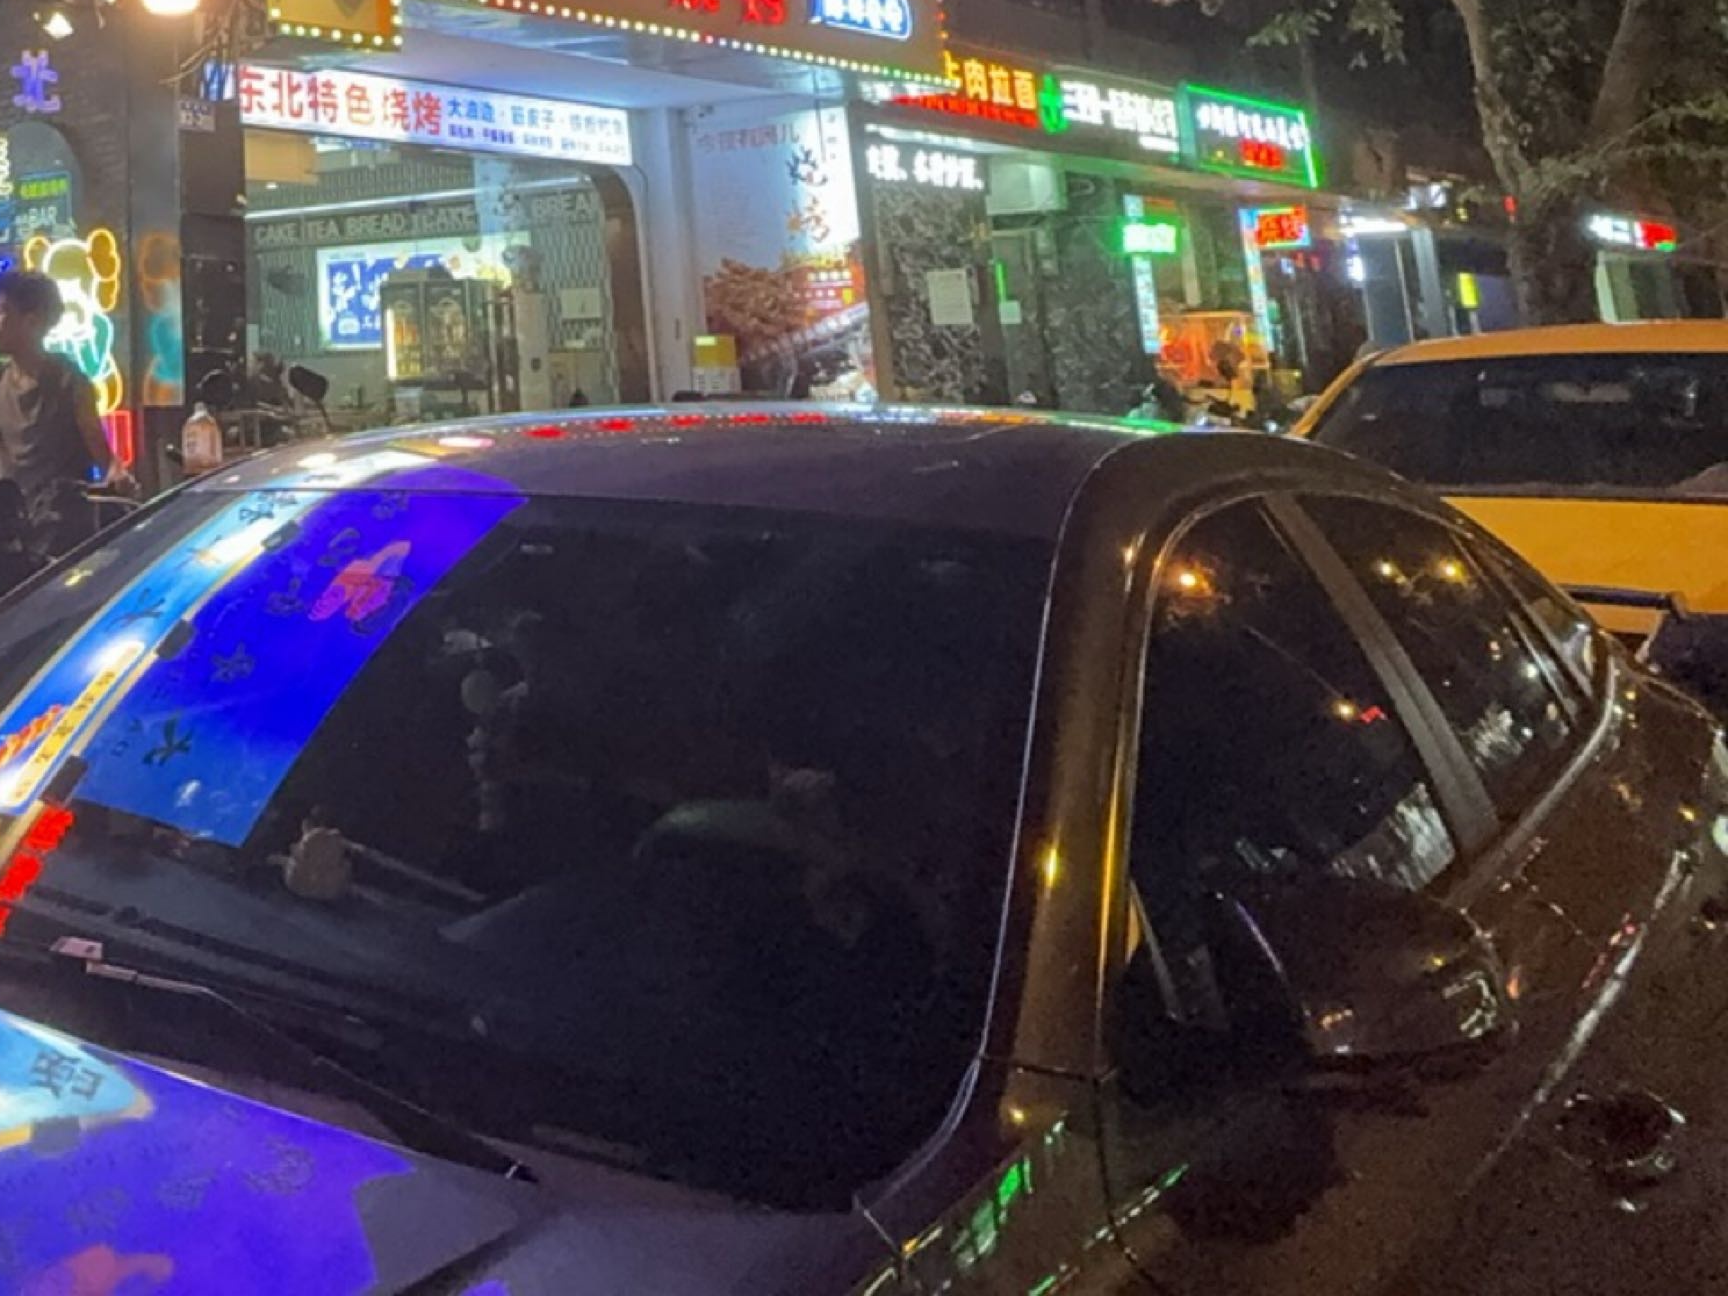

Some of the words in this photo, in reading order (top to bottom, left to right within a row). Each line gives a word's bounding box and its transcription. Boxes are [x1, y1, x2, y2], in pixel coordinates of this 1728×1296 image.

[238, 64, 442, 137] 东北特色烧烤
